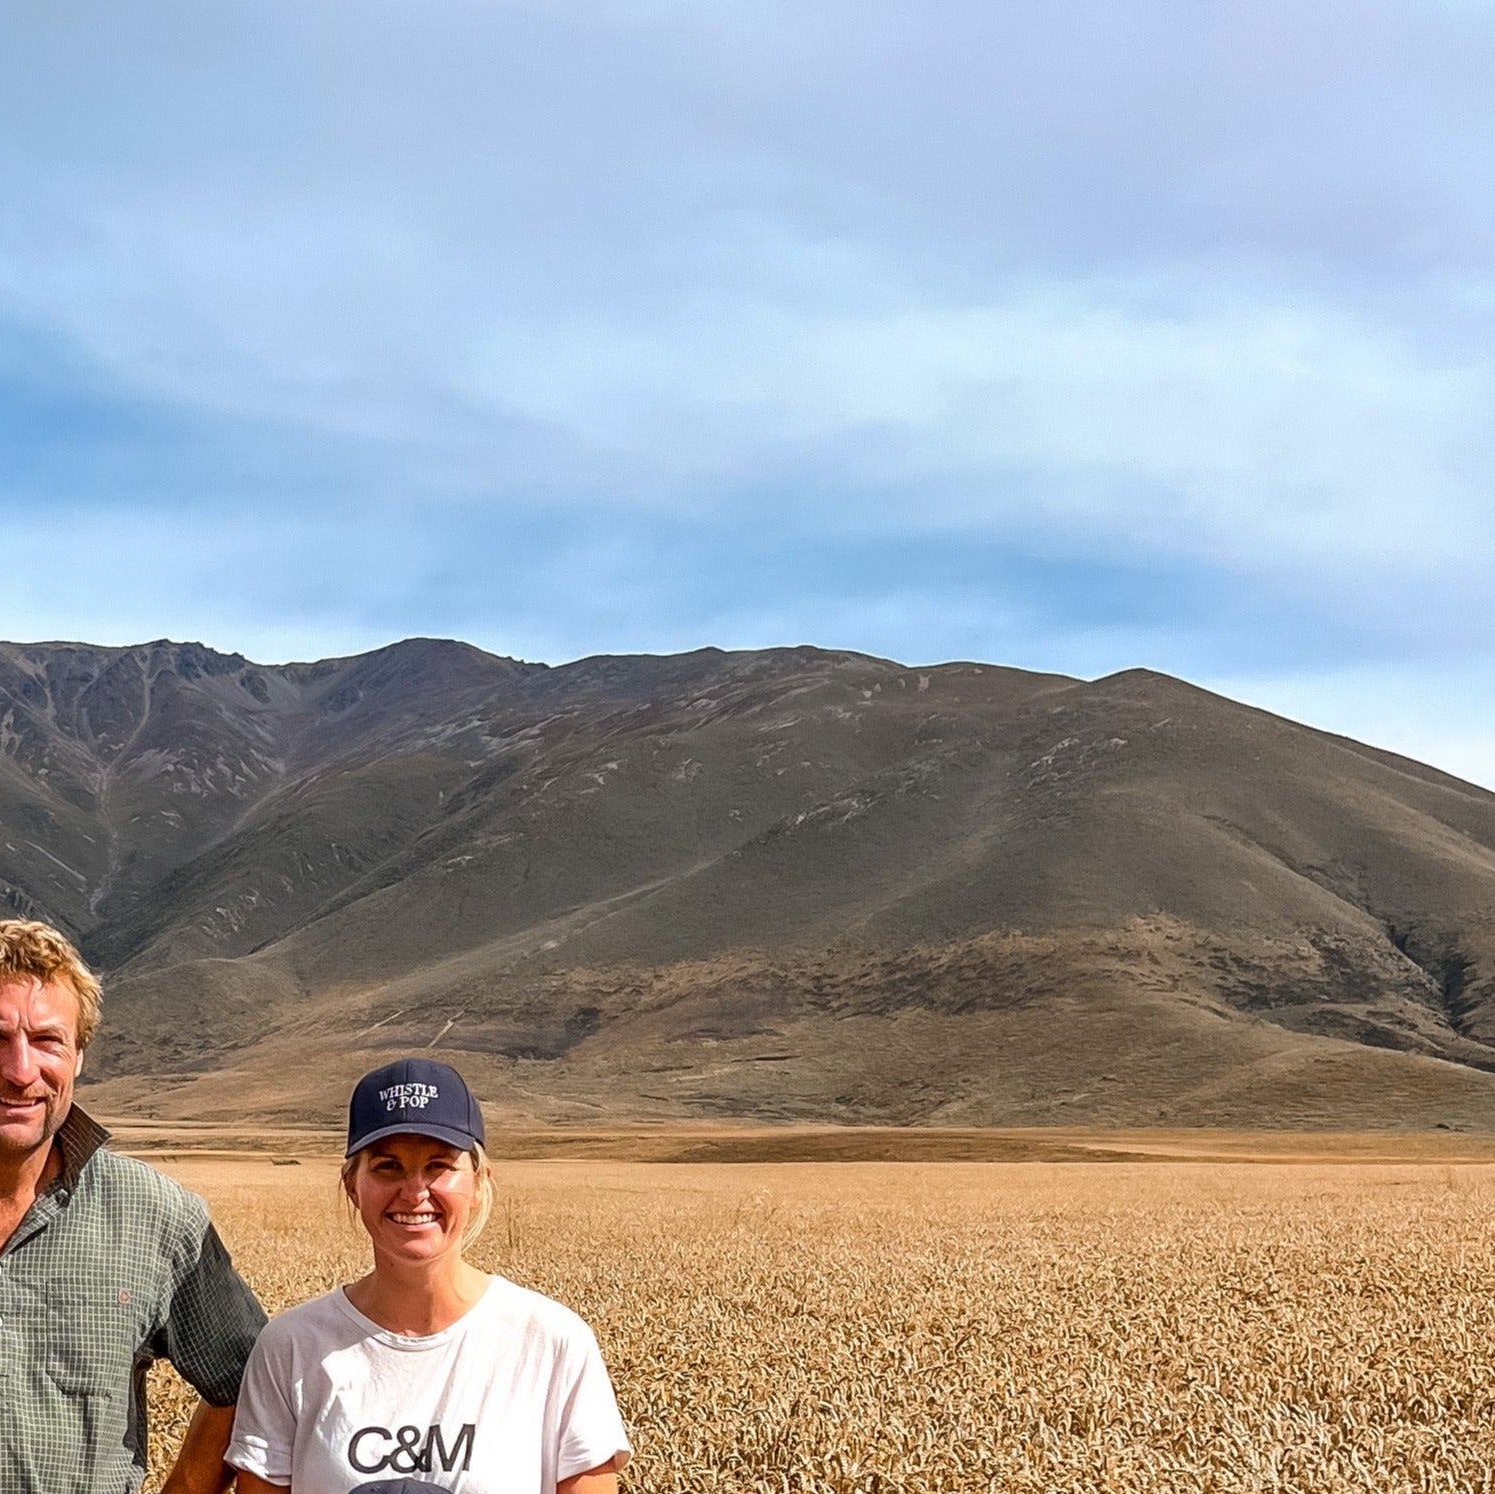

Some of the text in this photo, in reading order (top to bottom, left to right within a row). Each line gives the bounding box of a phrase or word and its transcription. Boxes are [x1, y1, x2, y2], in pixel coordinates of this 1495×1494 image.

[379, 1083, 438, 1101] WHISTLE
[386, 1095, 429, 1111] & POP
[348, 1423, 476, 1474] C&M
